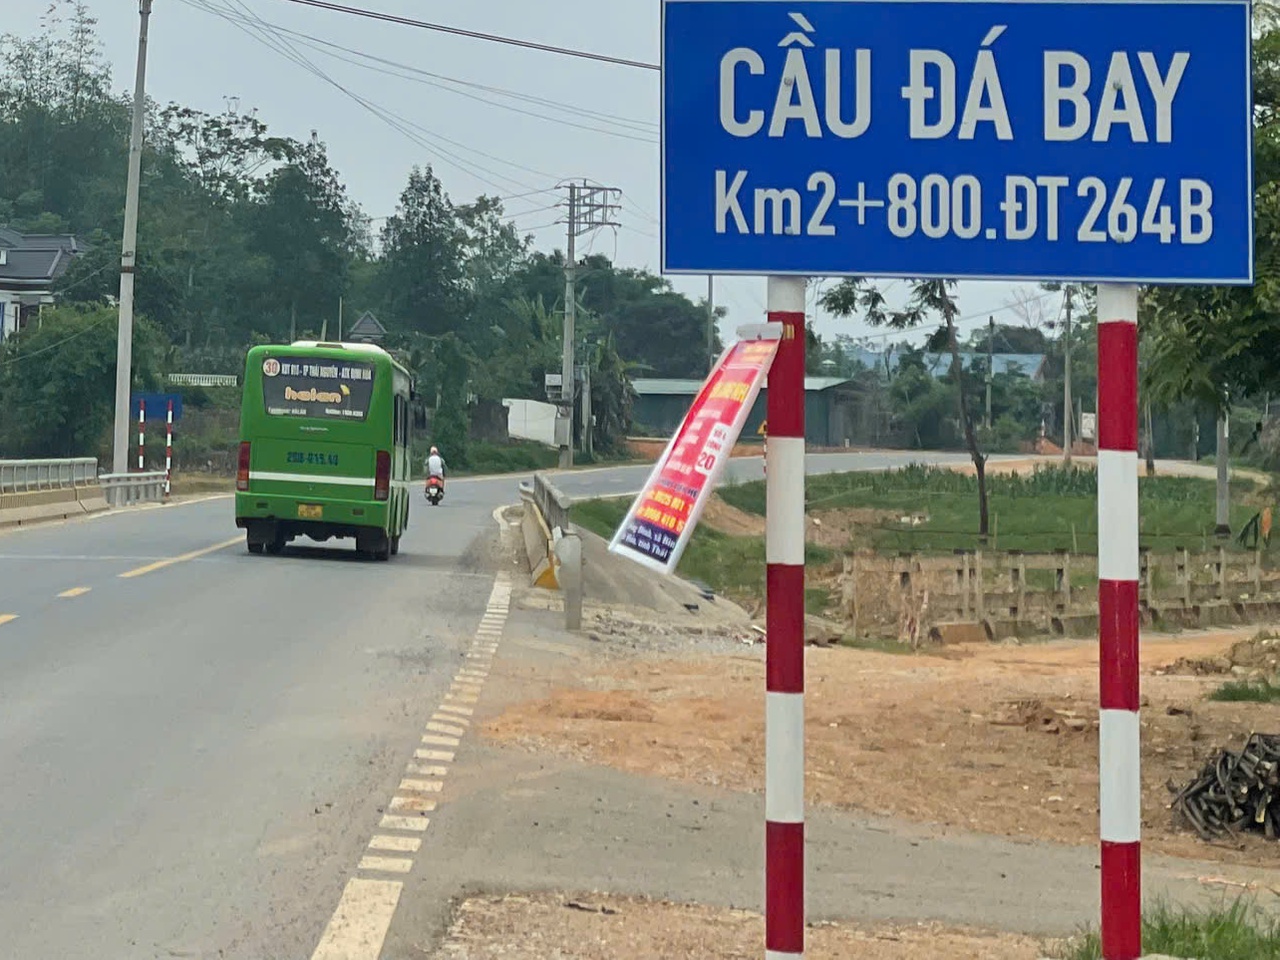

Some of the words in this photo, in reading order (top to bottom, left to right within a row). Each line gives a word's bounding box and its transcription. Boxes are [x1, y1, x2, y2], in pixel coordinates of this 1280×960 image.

[720, 12, 871, 137] CẦU
[901, 25, 1014, 139] ĐÁ
[1043, 50, 1191, 143] BAY
[265, 361, 278, 374] 30
[697, 451, 716, 470] 20
